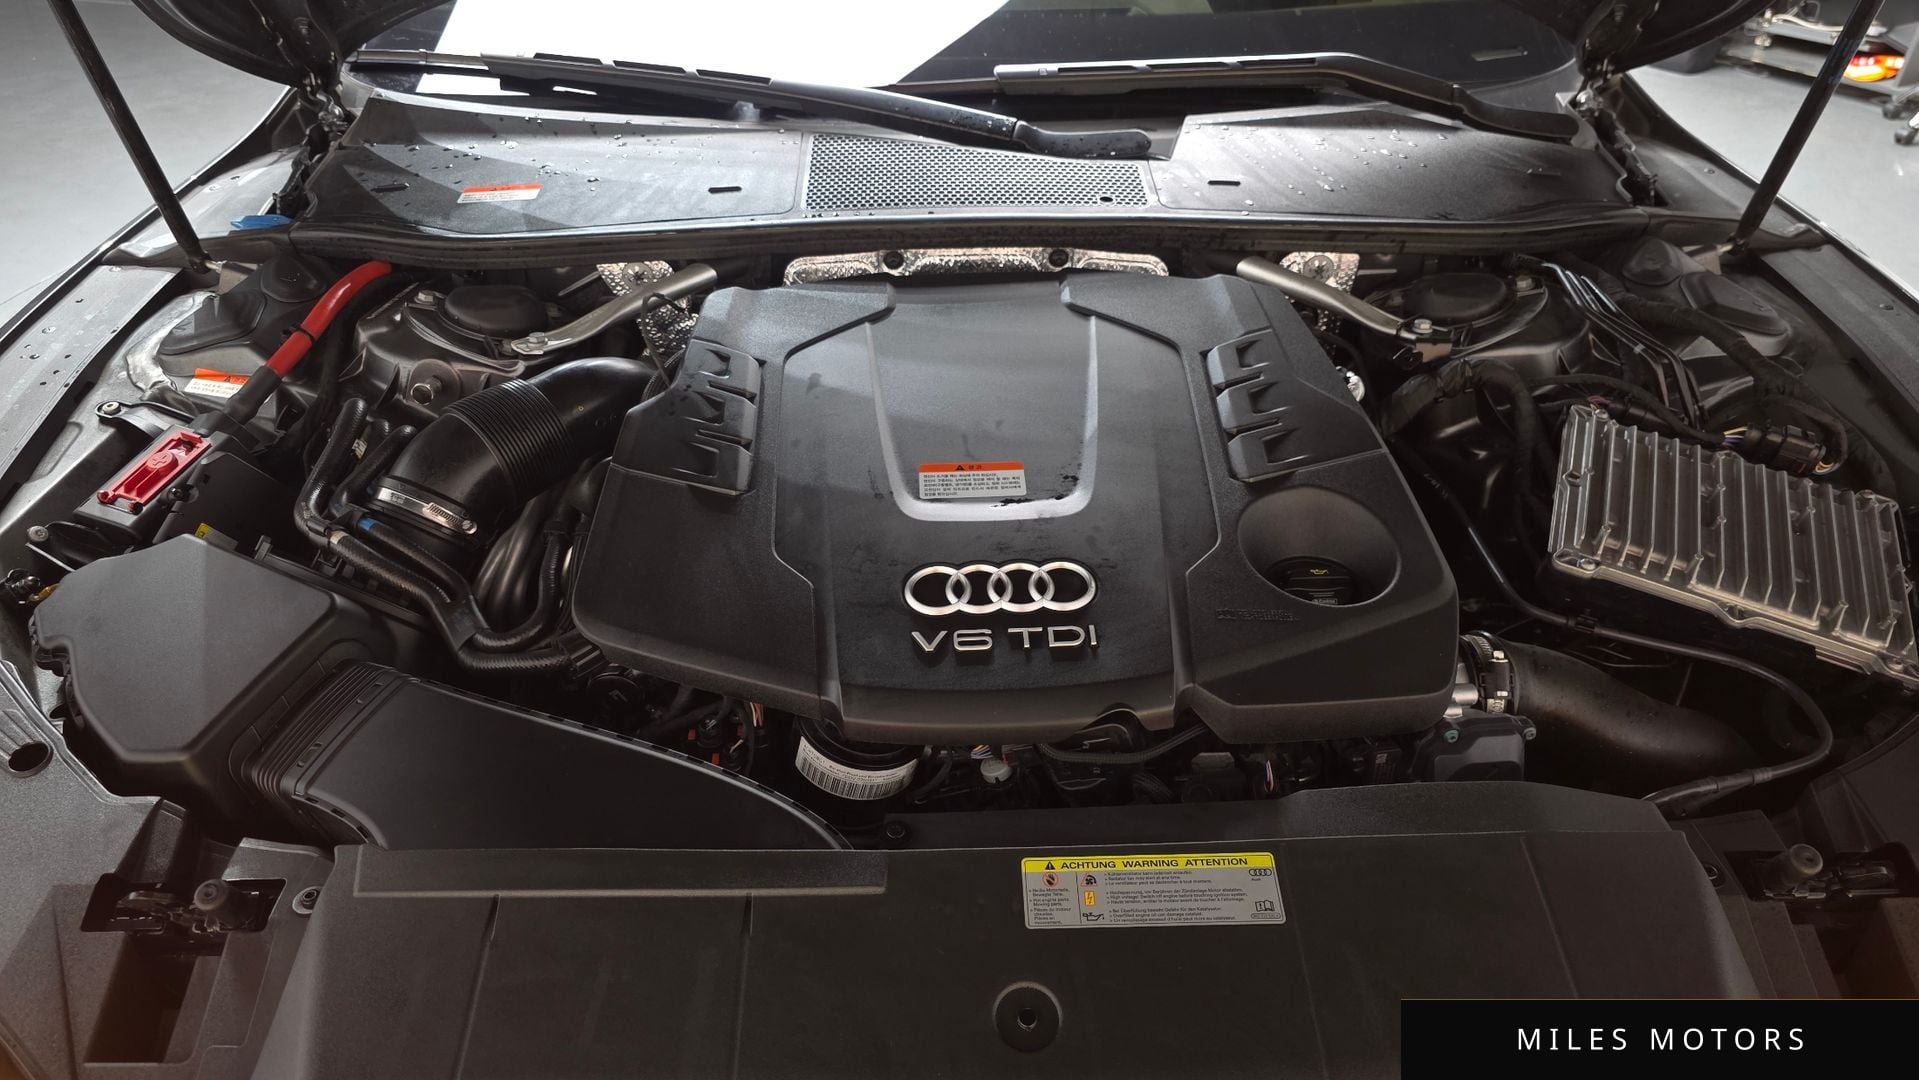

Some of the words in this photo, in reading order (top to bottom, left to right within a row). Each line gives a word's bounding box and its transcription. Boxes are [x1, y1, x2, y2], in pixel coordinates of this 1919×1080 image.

[911, 628, 993, 652] V6
[1007, 624, 1098, 648] TDI
[1060, 860, 1116, 870] ACHTUNG
[1122, 859, 1179, 868] WARNING
[1185, 858, 1248, 866] ATTENTION
